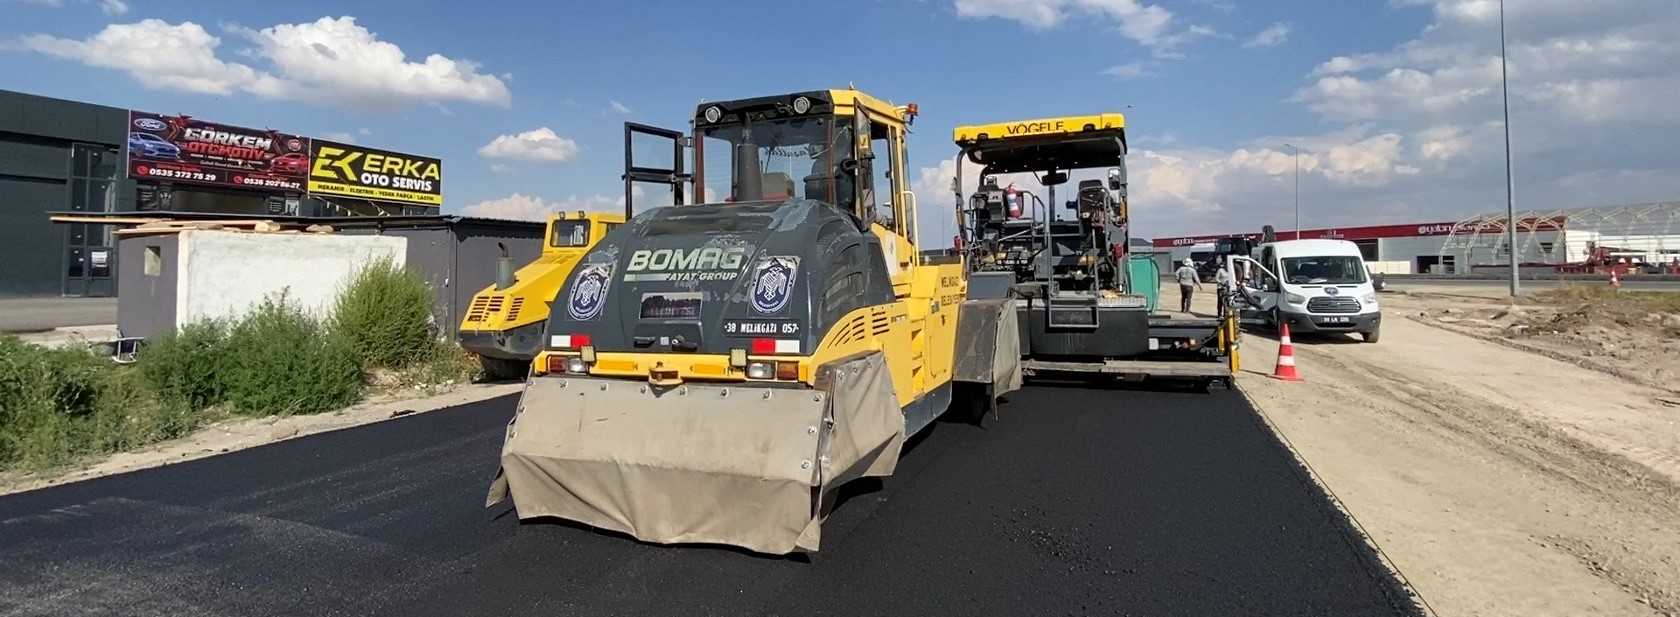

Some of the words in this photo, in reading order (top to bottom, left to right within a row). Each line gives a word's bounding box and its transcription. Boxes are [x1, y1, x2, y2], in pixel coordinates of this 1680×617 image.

[1006, 121, 1065, 135] VÖGELE
[149, 168, 173, 177] 0535
[174, 170, 191, 179] 372
[193, 172, 204, 180] 75
[362, 153, 440, 181] ERKA
[361, 172, 389, 186] OTO
[627, 248, 745, 271] BOMAG
[699, 272, 738, 281] GROUP
[727, 322, 737, 333] 38
[782, 323, 797, 334] 057
